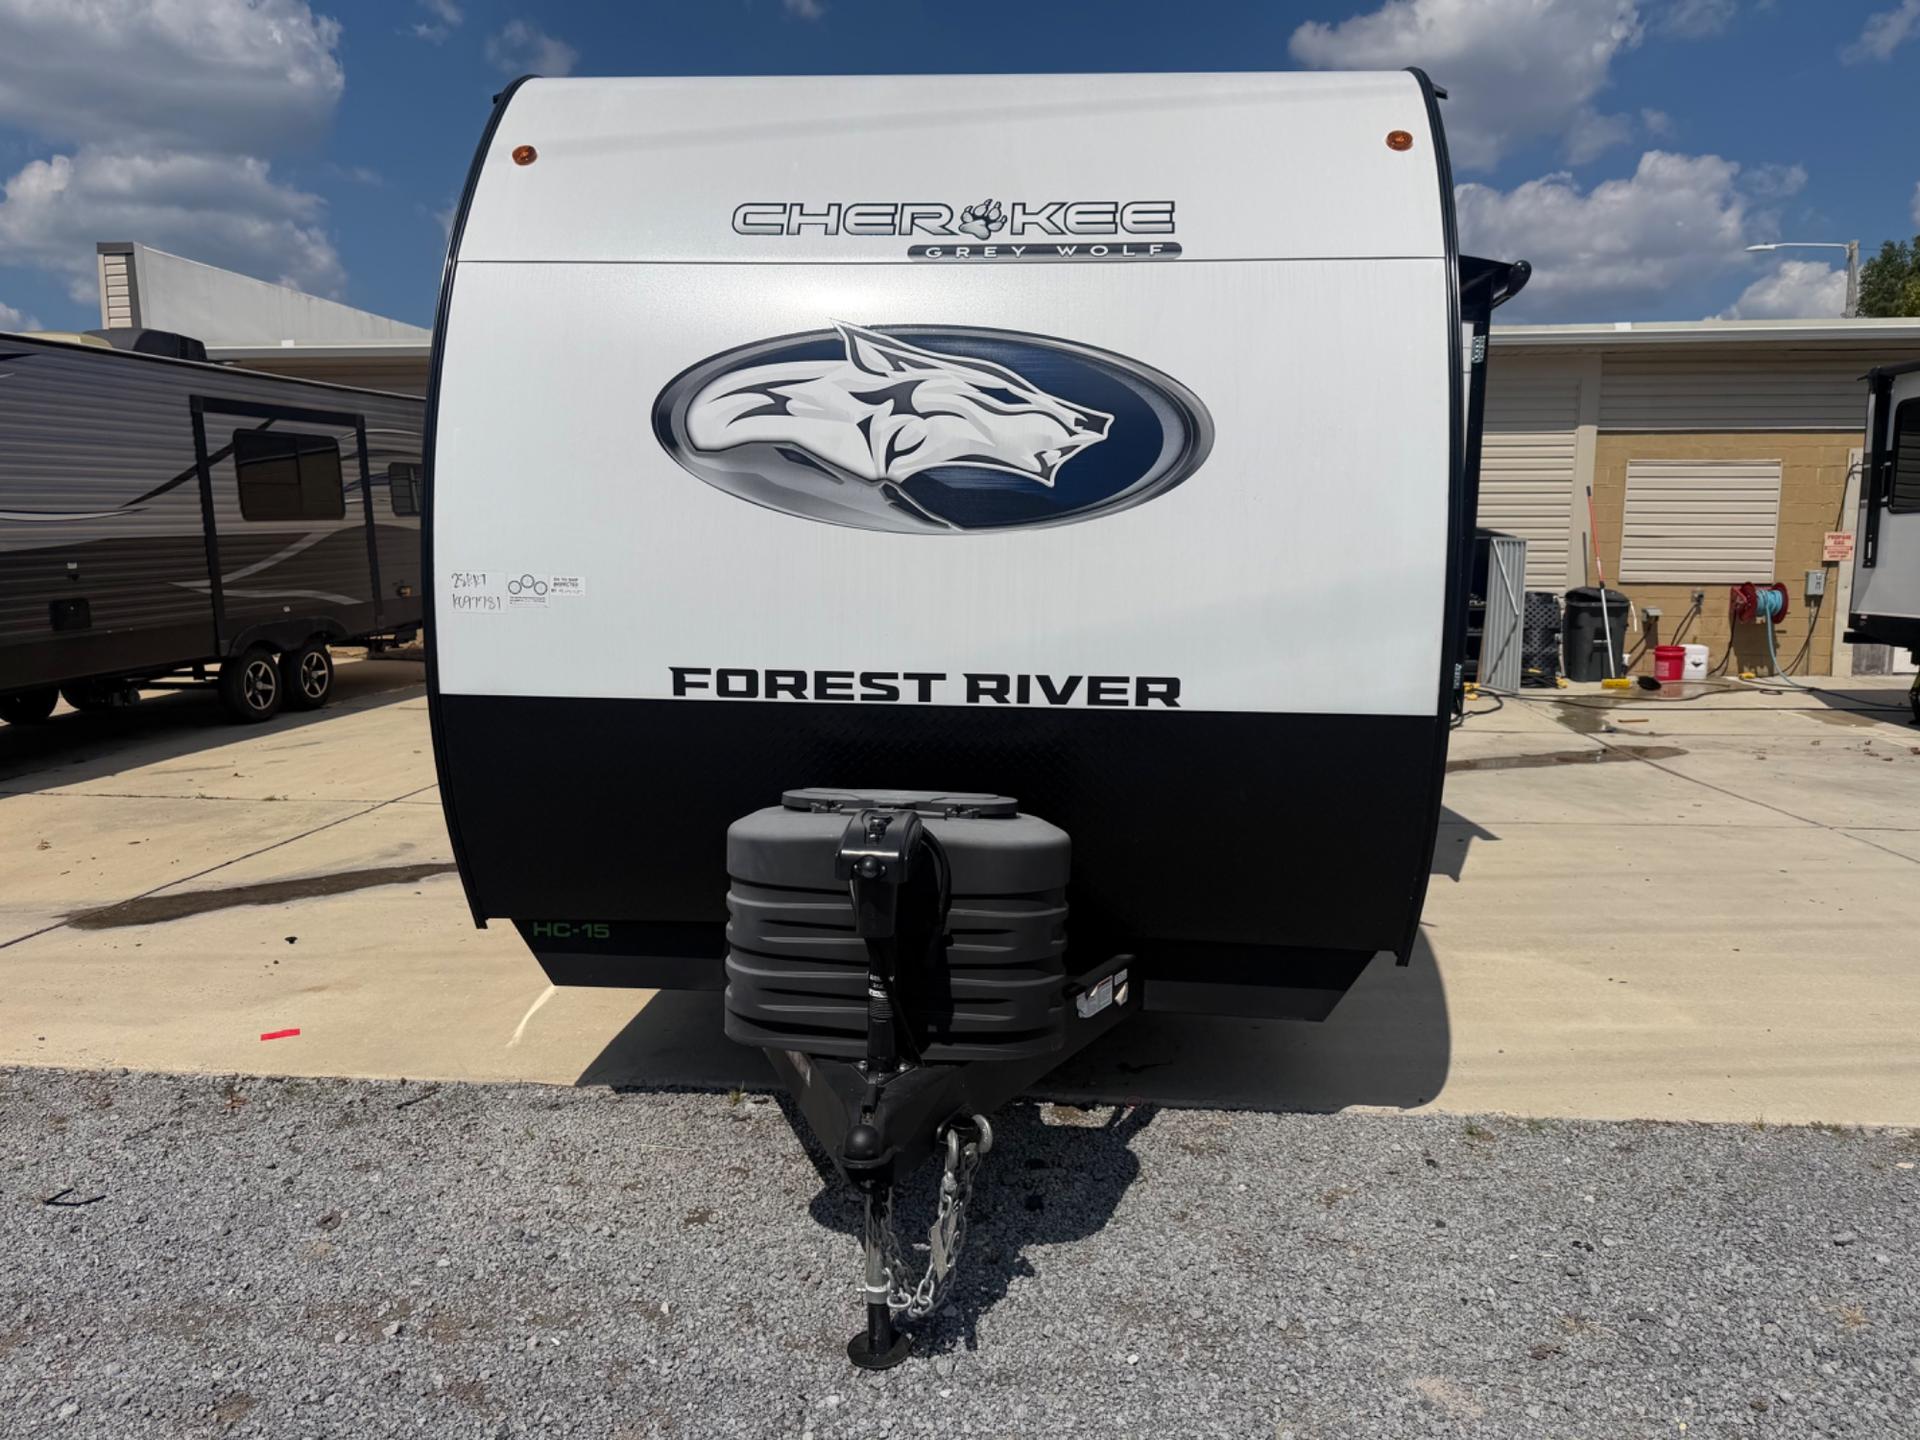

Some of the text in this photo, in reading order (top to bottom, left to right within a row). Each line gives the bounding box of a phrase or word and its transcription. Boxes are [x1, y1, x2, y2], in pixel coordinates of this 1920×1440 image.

[924, 244, 1164, 260] GREY WOLF
[668, 667, 1182, 709] FOREST RIVER
[532, 922, 611, 939] HC-15
